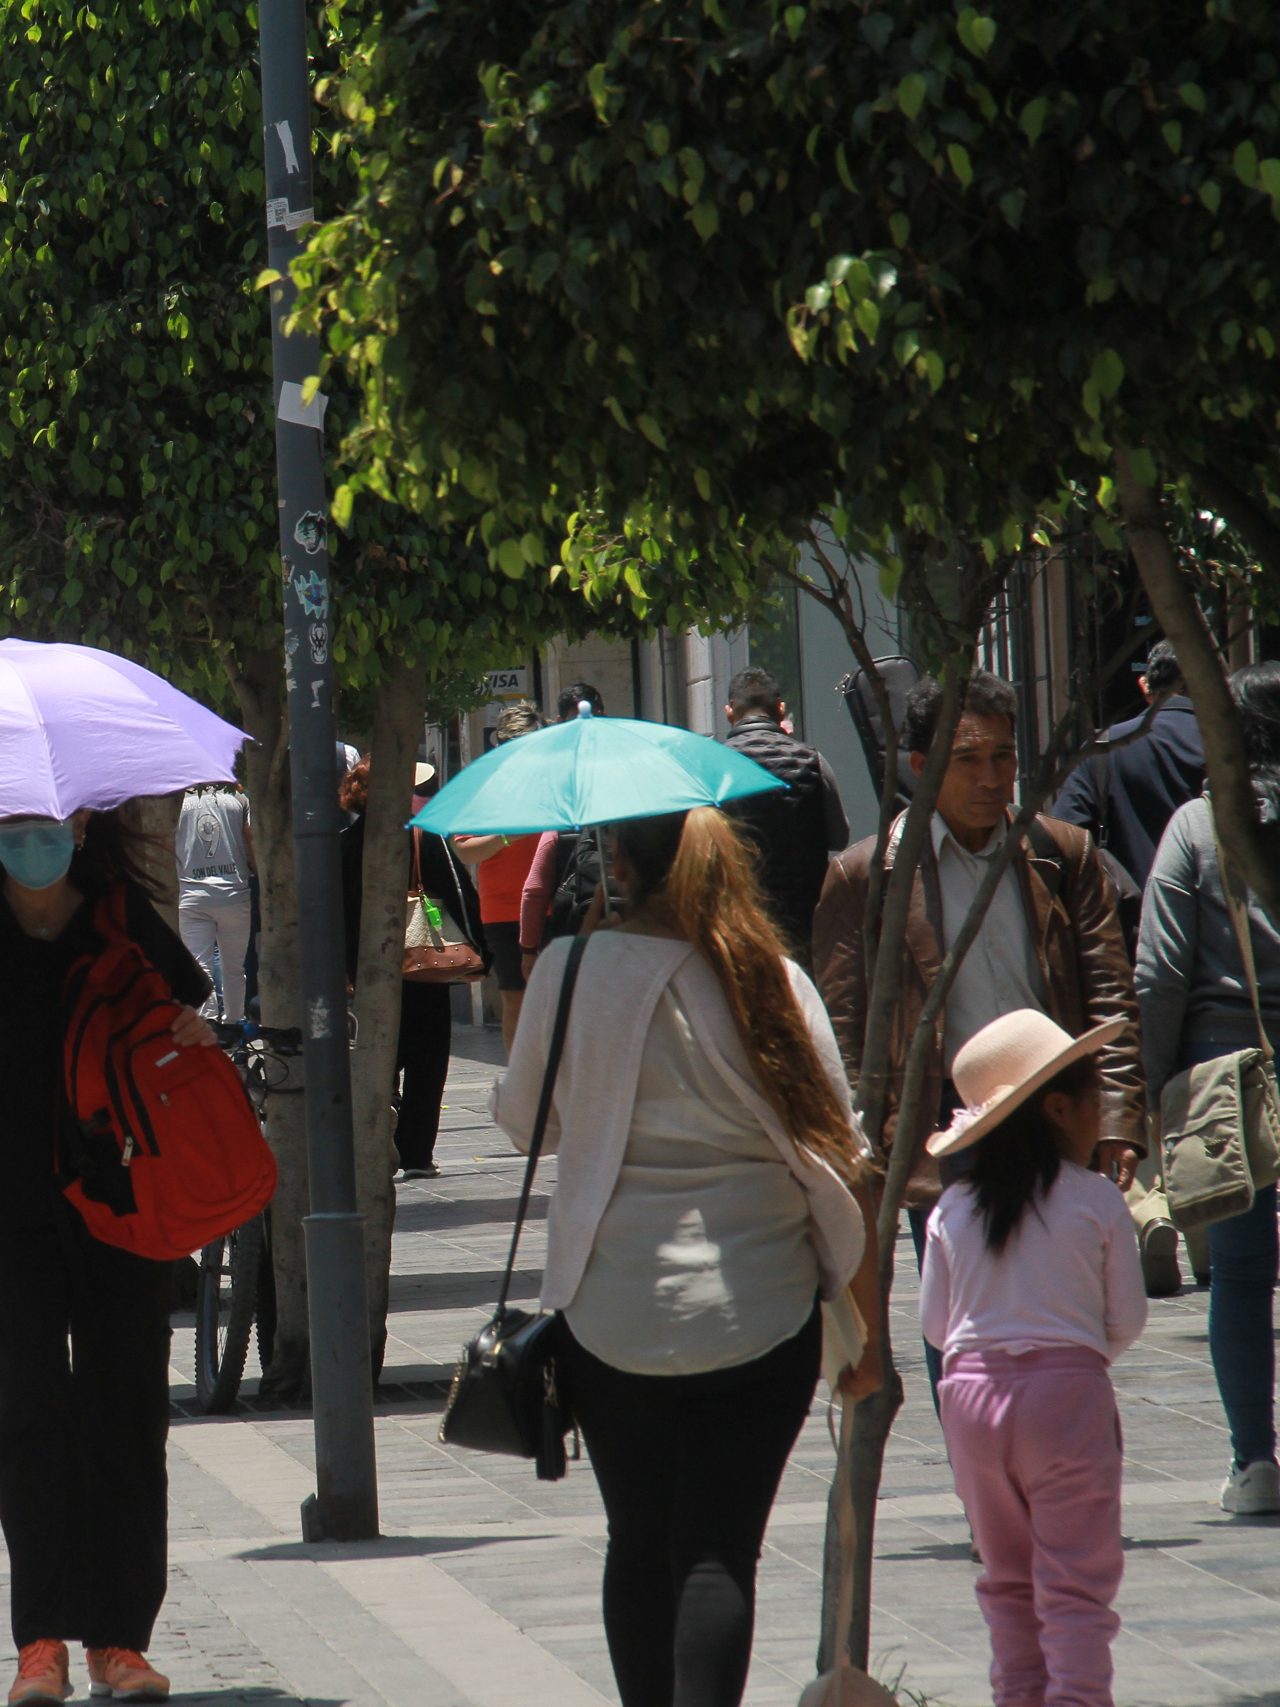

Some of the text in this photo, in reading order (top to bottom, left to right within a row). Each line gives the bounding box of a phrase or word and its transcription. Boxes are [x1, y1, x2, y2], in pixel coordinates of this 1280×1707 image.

[197, 814, 220, 858] 9
[206, 865, 218, 876] DEL
[218, 863, 237, 875] VALLE
